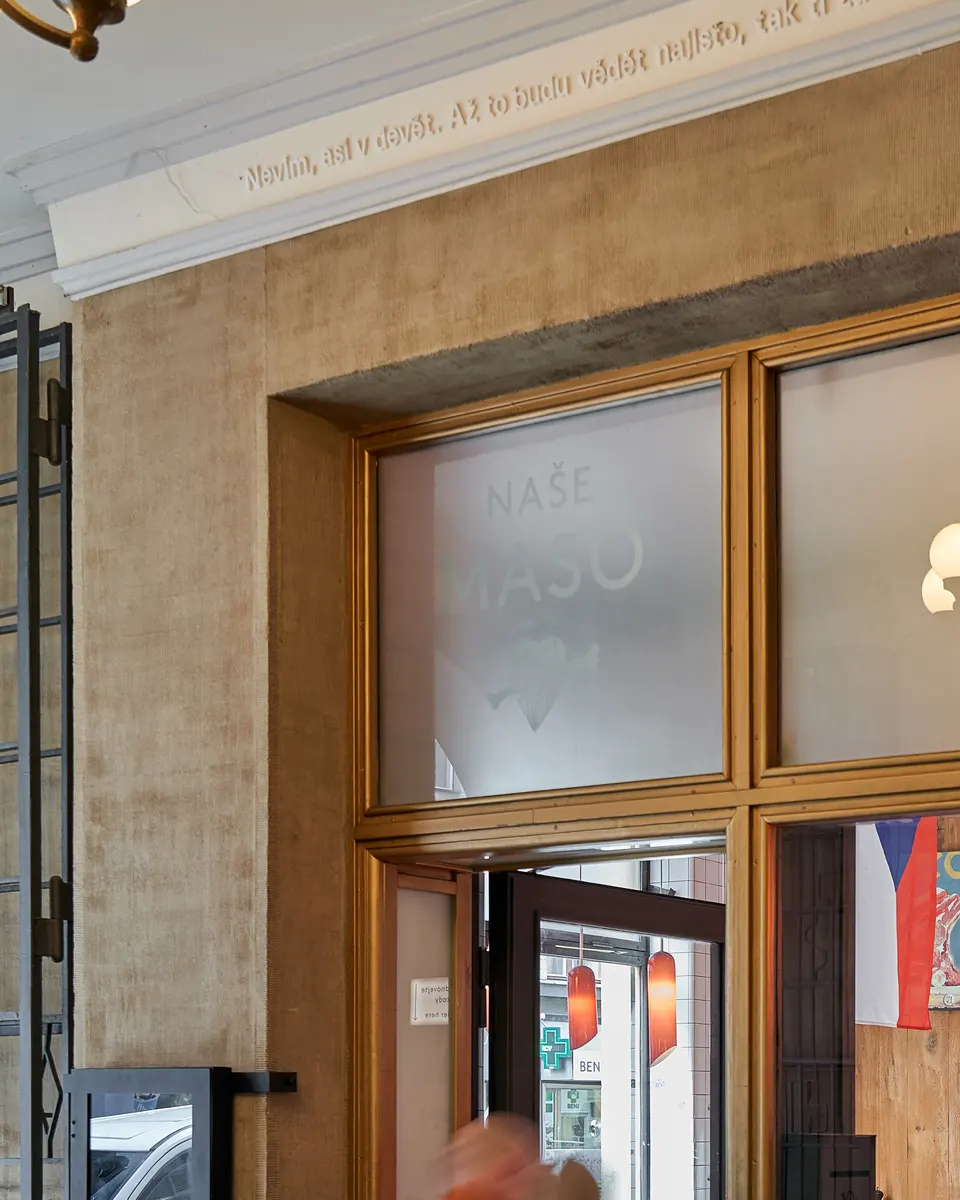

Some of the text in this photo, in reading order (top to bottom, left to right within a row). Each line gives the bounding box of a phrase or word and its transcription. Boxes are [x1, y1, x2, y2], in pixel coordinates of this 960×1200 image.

[488, 93, 511, 117] to
[514, 75, 574, 110] budu
[487, 460, 594, 519] NAŠE
[440, 528, 644, 613] MASO
